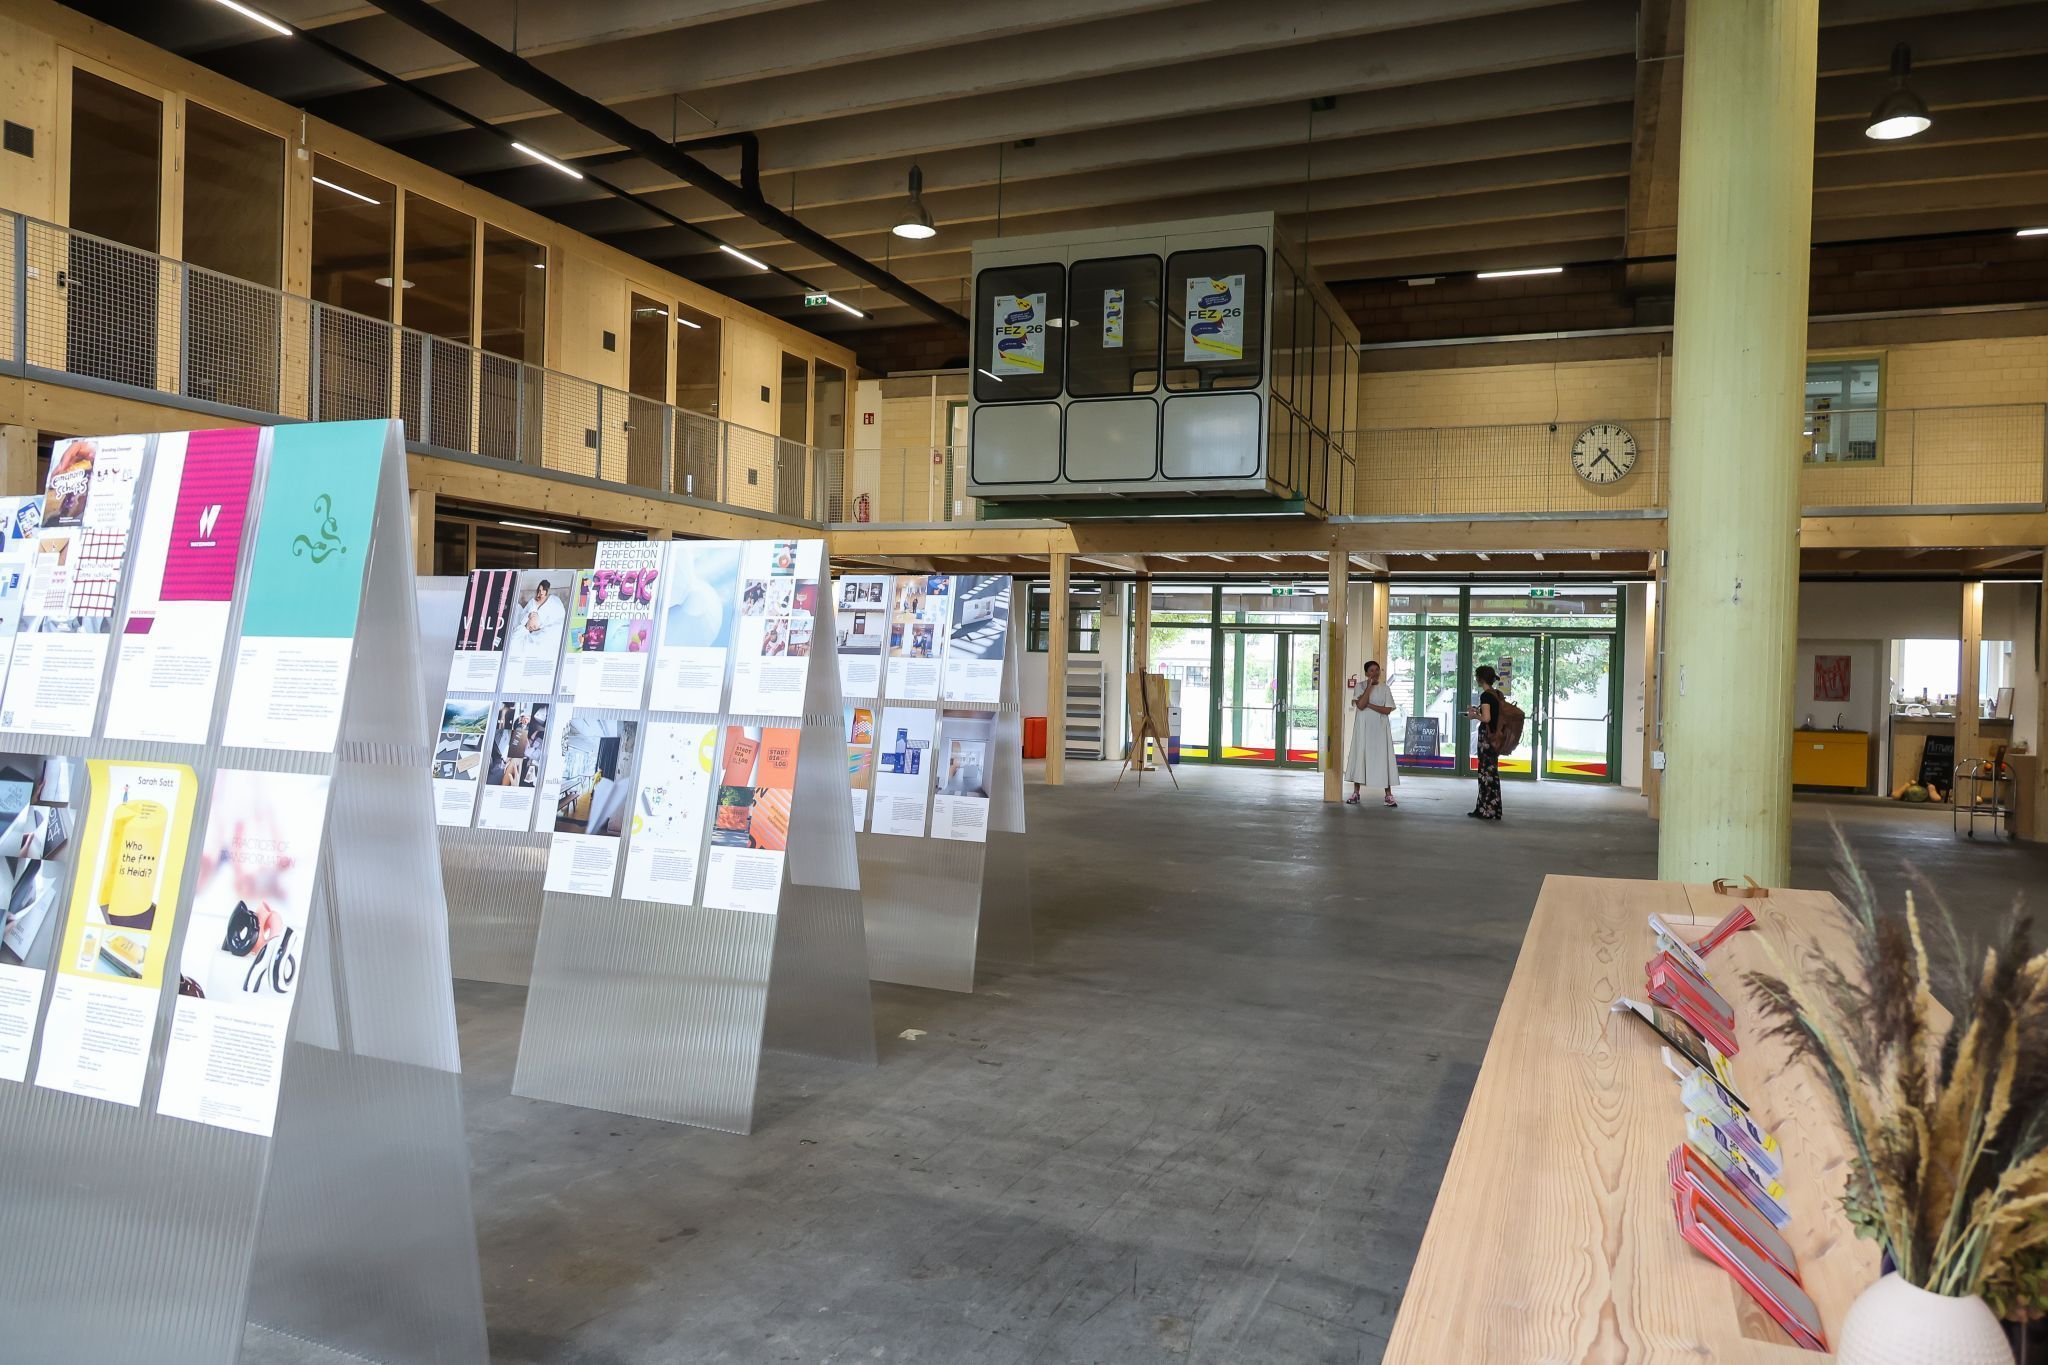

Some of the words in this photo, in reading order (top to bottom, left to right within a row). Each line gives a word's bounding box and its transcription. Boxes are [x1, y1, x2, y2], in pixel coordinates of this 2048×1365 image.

[1188, 309, 1217, 320] FEZ
[1222, 308, 1241, 318] 26
[996, 325, 1021, 335] FEZ
[1026, 325, 1043, 334] 26
[600, 549, 658, 559] PERFECTION
[599, 559, 656, 569] PERFECTION
[736, 746, 752, 755] STADT
[138, 776, 157, 787] Sarah
[159, 777, 174, 788] Satt
[47, 825, 62, 843] 44
[125, 839, 142, 851] Who
[122, 853, 136, 863] the
[119, 865, 125, 875] is
[126, 866, 152, 878] Heidi?
